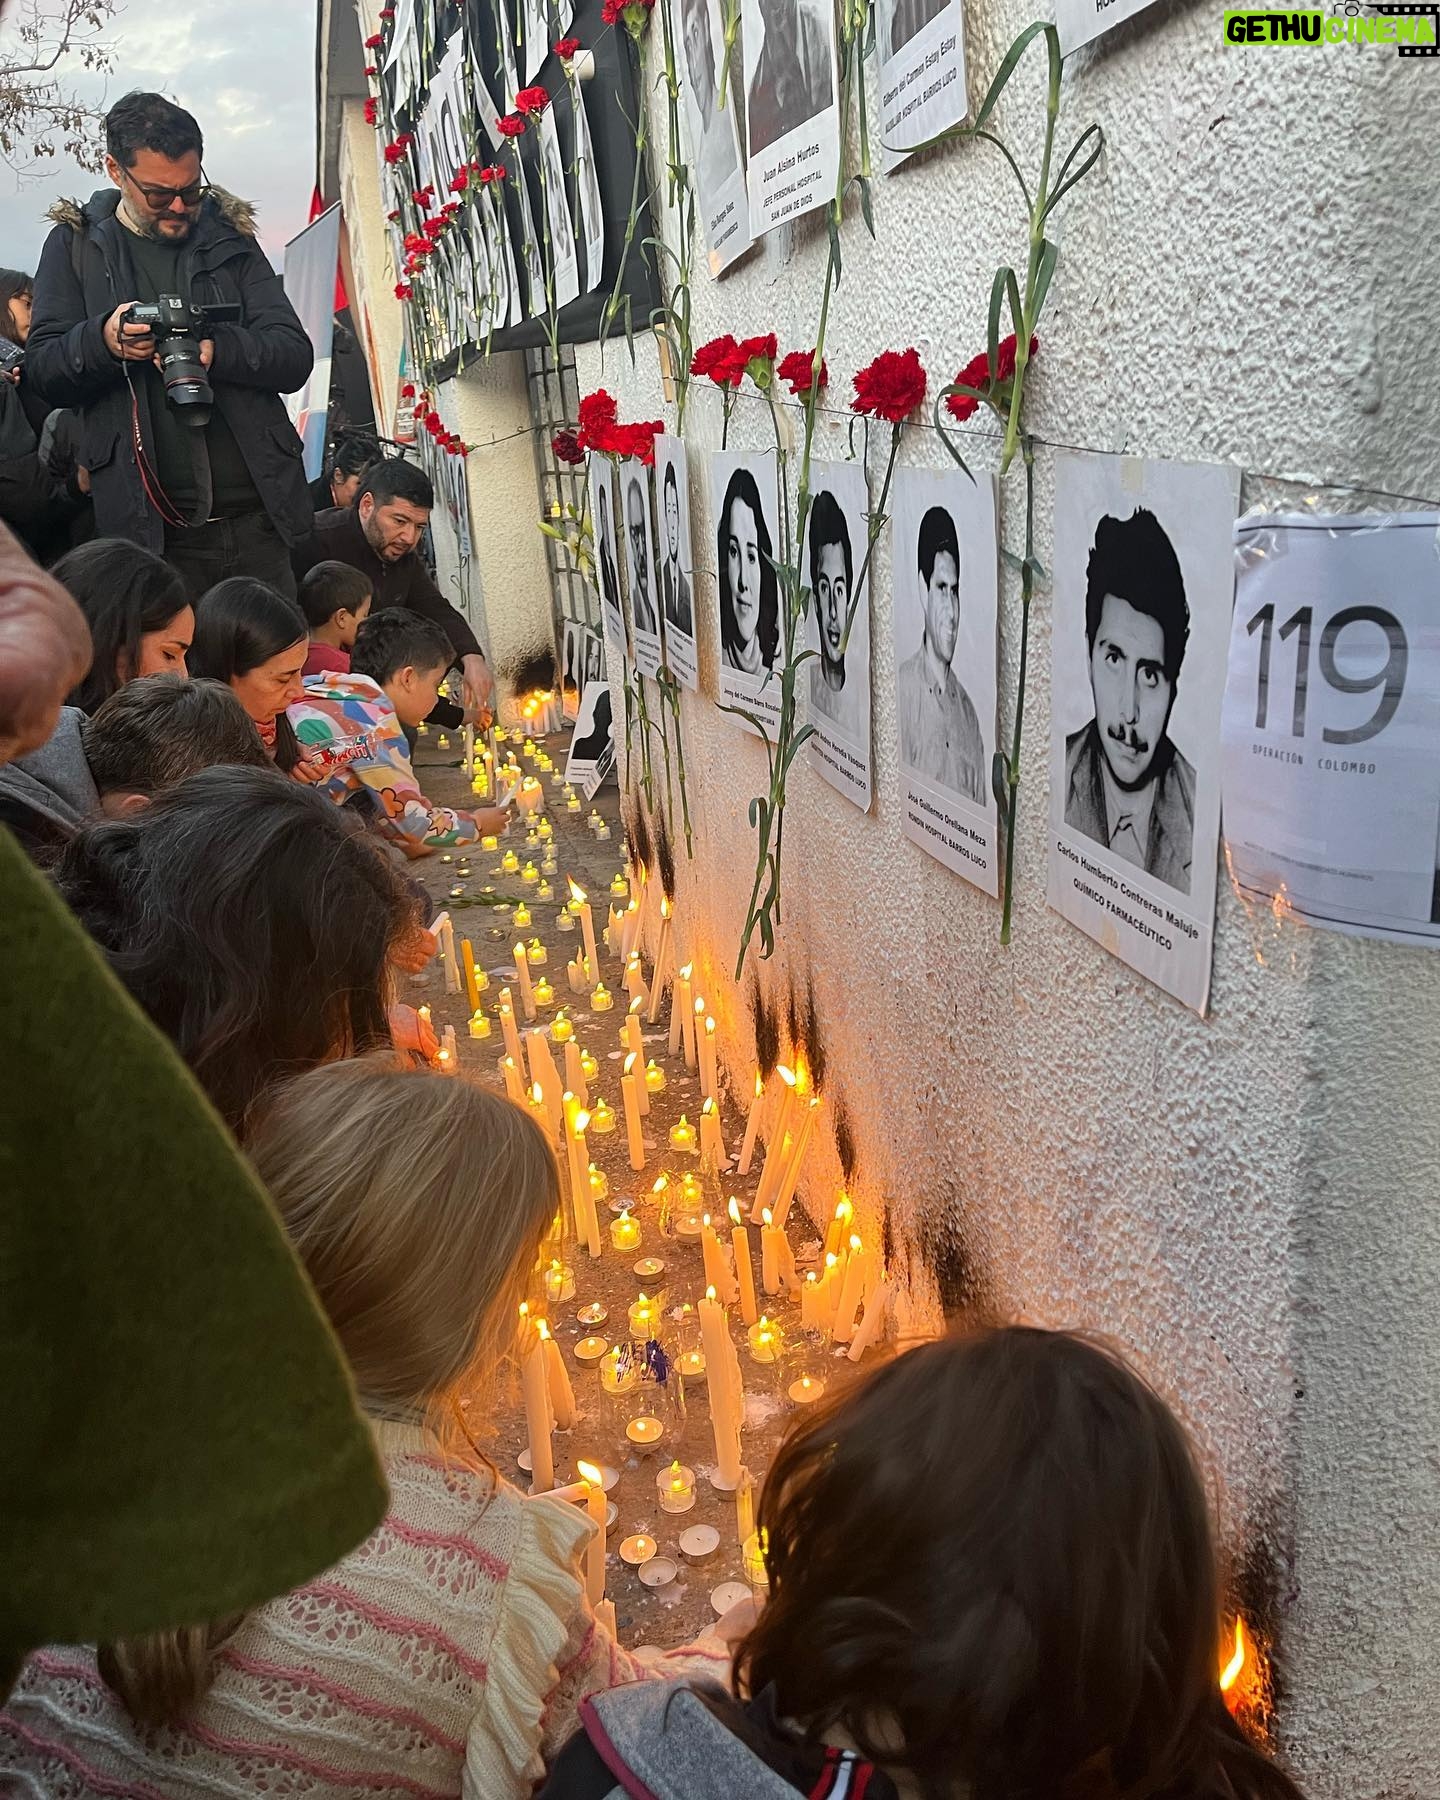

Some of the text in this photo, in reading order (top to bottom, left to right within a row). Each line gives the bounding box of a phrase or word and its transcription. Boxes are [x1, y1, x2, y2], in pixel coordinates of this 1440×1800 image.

[763, 143, 820, 183] Juan Alsina Hurtos
[770, 193, 814, 222] SAN JUAN DE DIOS
[773, 182, 797, 203] PERSONAL
[797, 169, 823, 190] HOSPITAL
[1246, 603, 1409, 745] 119
[1317, 757, 1377, 775] COLOMBO
[919, 798, 944, 821] Guillermo
[944, 814, 969, 837] Orellana
[969, 829, 987, 847] Meza
[924, 823, 948, 846] HOSPITAL
[970, 852, 987, 870] LUCO
[1057, 841, 1200, 940] Carlos Humberto Contreras Maluje
